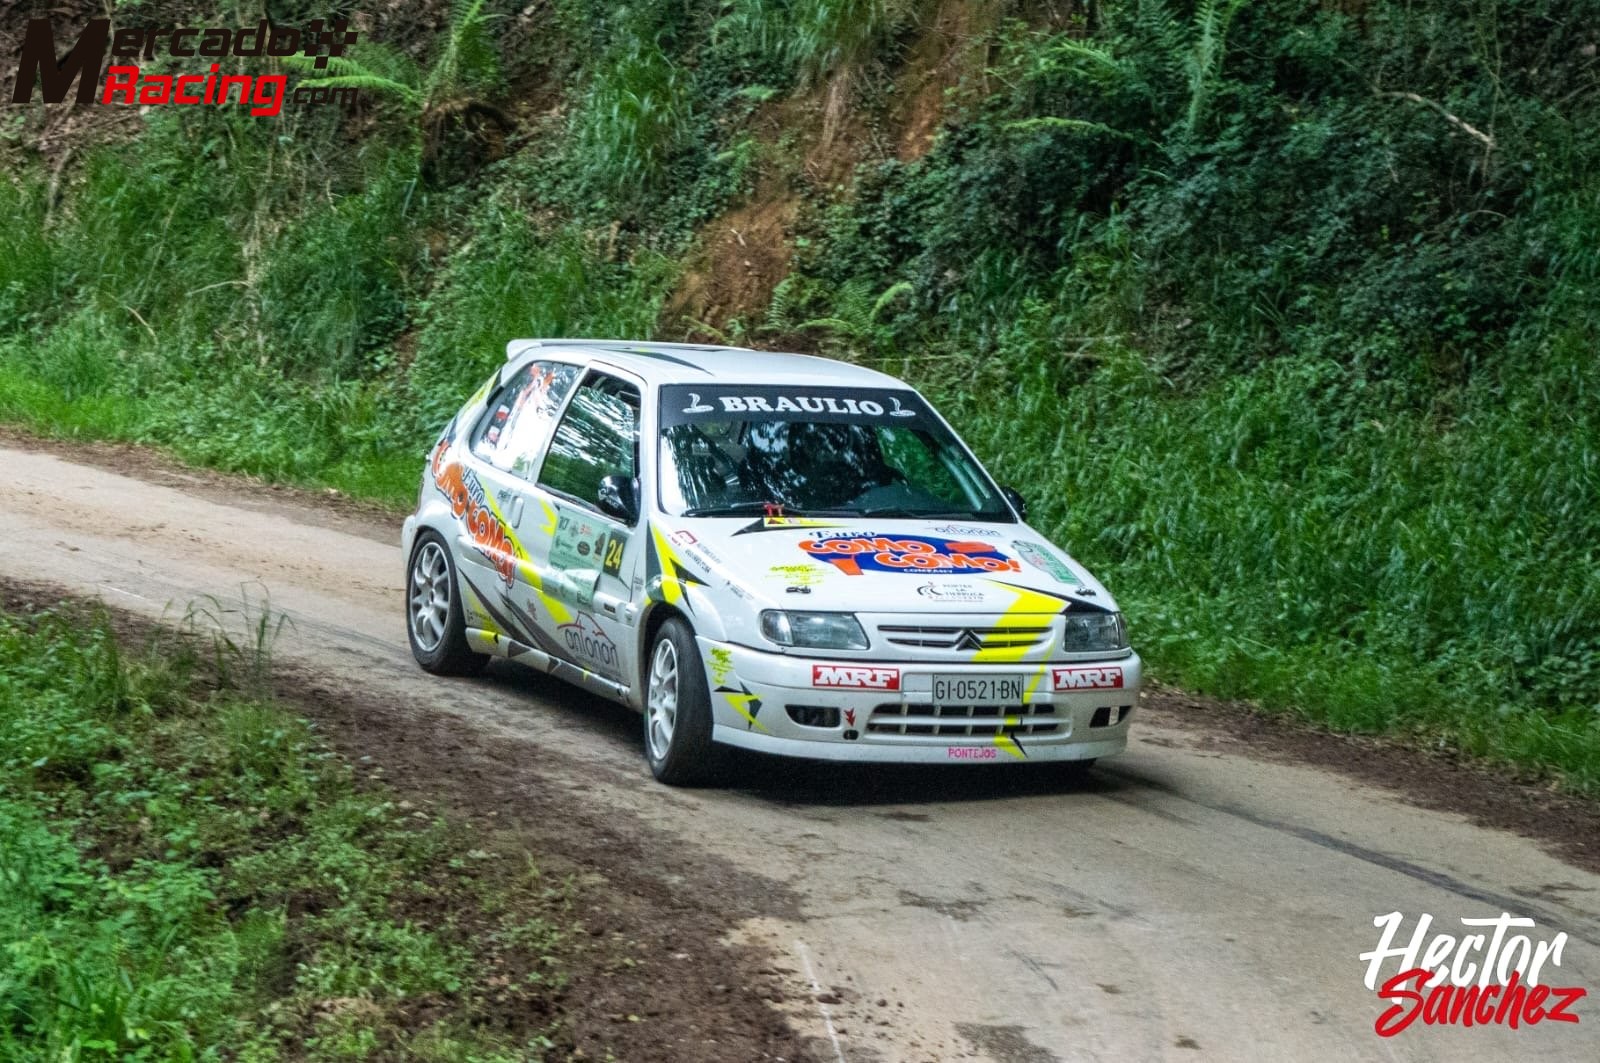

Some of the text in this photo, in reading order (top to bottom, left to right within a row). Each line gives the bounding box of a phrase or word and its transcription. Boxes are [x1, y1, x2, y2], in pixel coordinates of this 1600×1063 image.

[718, 396, 884, 416] BRAULIO
[605, 539, 624, 570] 24
[798, 537, 936, 555] COMO
[815, 666, 898, 689] MRF
[1055, 668, 1121, 689] MRF
[935, 680, 1020, 699] GI-0521-BN
[947, 747, 997, 759] PONTEJOS
